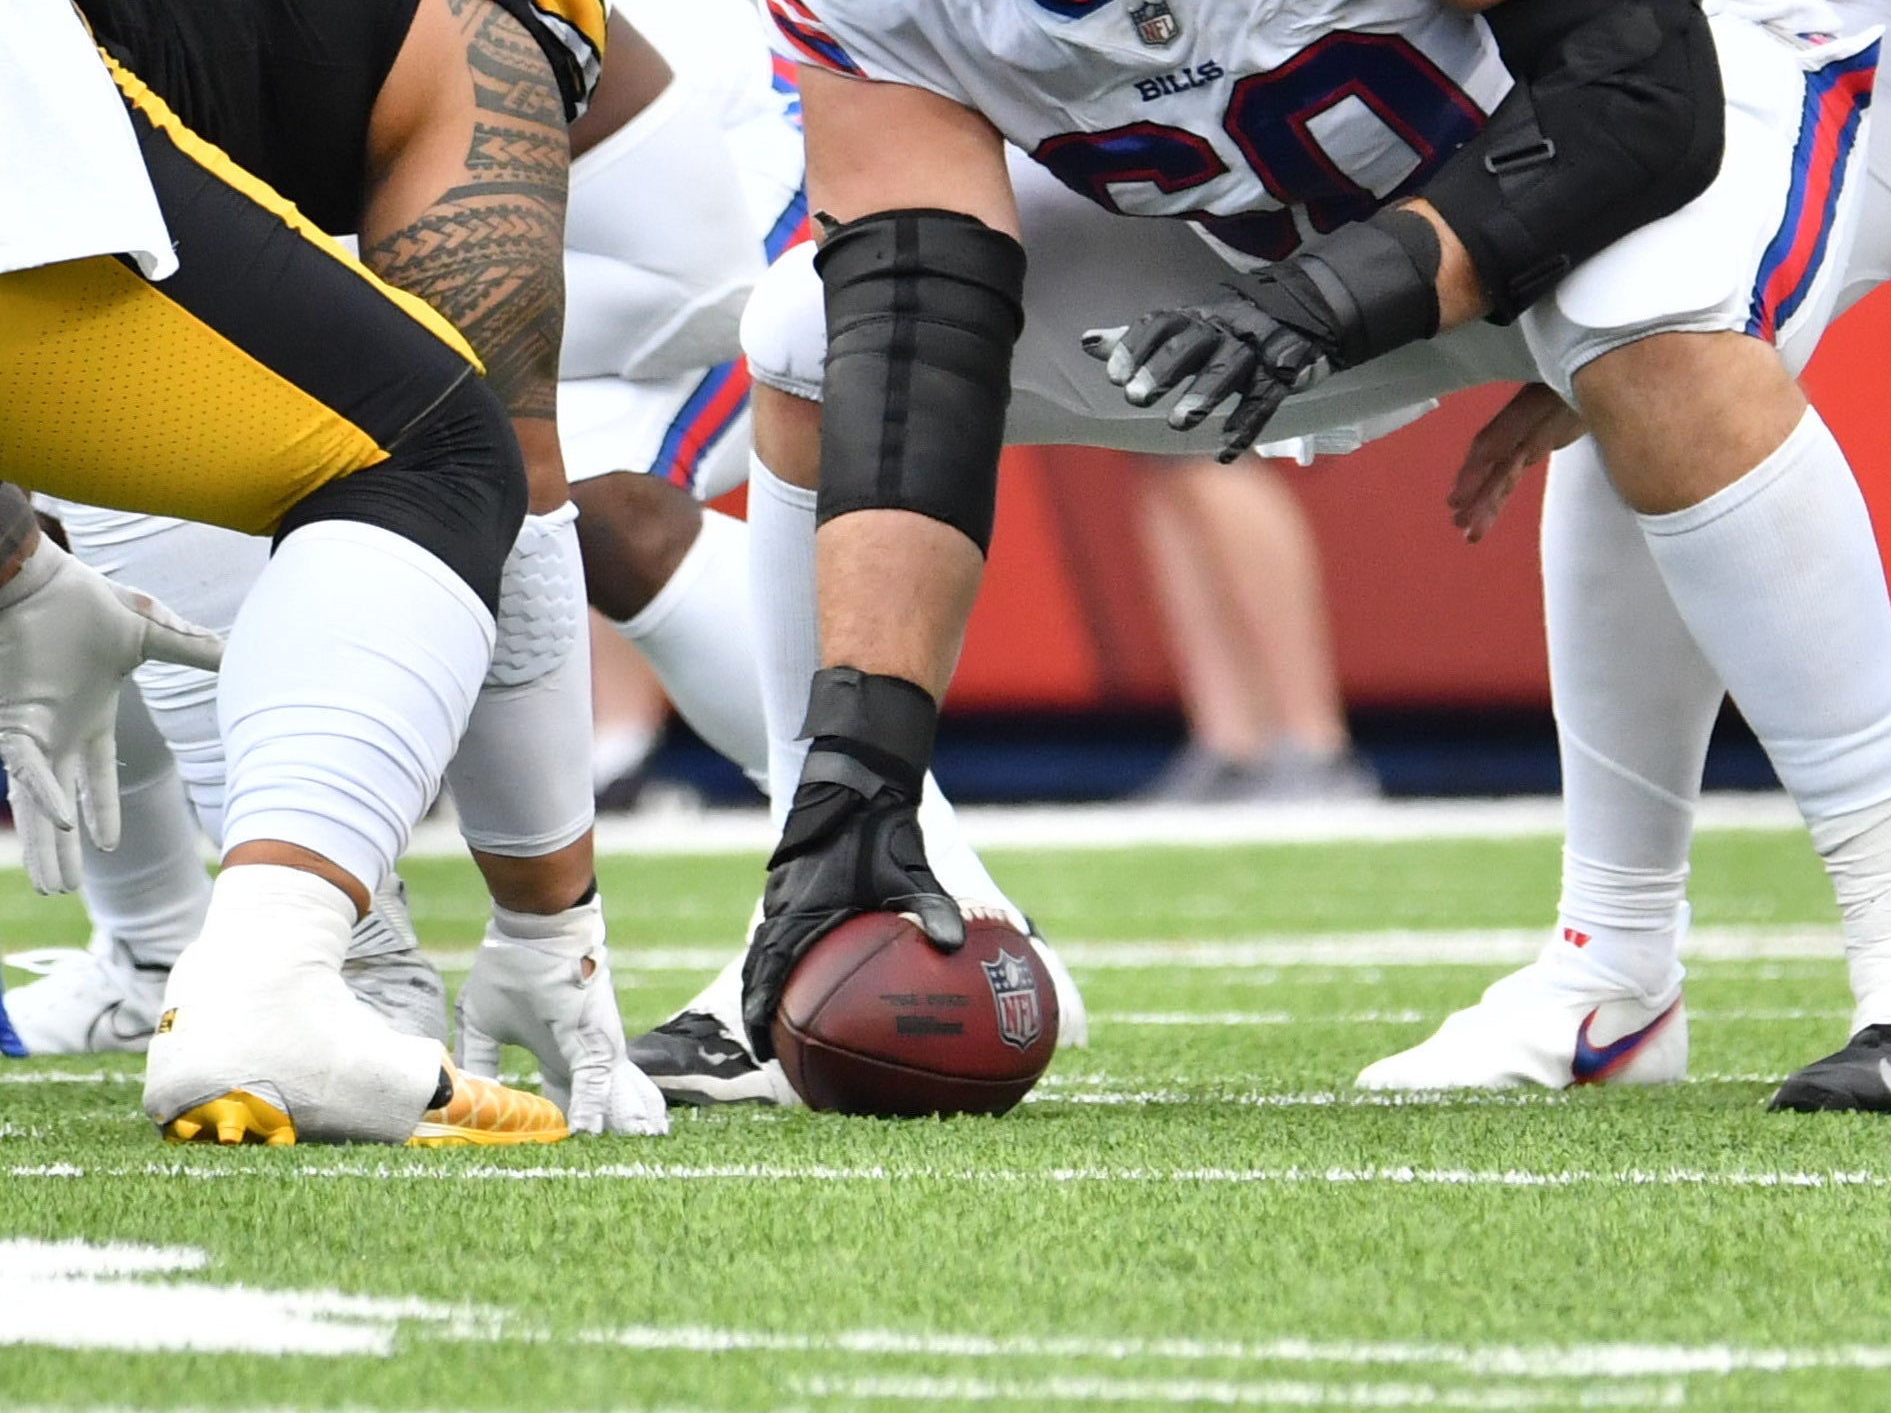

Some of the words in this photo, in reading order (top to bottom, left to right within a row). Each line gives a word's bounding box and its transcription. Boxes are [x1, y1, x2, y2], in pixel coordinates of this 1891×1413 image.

[1134, 58, 1226, 102] BILLS
[1029, 29, 1488, 262] 60
[1001, 993, 1043, 1037] NFL
